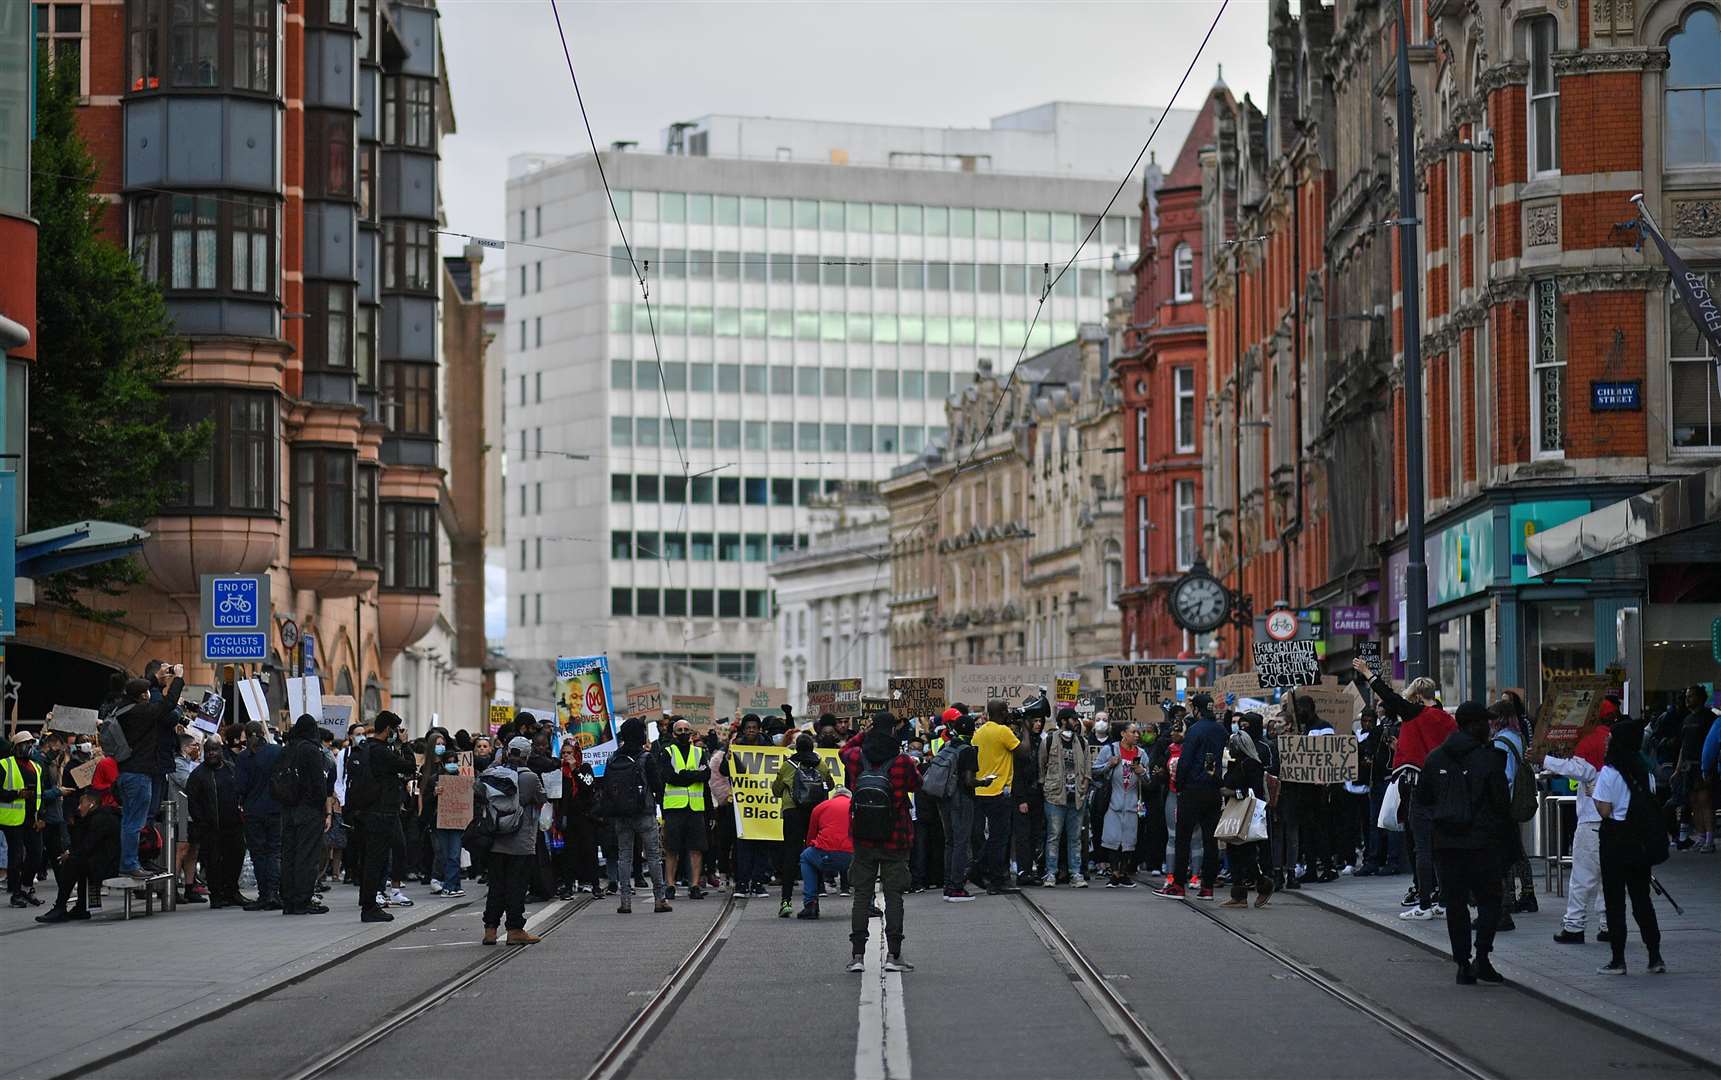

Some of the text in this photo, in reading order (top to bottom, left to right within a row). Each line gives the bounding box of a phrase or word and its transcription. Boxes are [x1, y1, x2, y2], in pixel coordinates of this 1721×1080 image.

[1685, 272, 1721, 336] FRASER
[1542, 280, 1556, 361] DENTAL
[1597, 388, 1634, 396] CHERRY
[1599, 396, 1633, 404] STREET
[1546, 371, 1559, 450] SURGERY
[218, 583, 254, 591] END OF
[220, 615, 251, 623] ROUTE
[1335, 621, 1370, 630] CAREERS
[213, 637, 258, 645] CYCLISTS
[1274, 640, 1314, 653] MENTALITY
[210, 646, 262, 654] DISMOUNT
[1287, 650, 1315, 663] CHANGE
[1103, 665, 1114, 680] IF
[1117, 664, 1134, 678] YOU
[1159, 664, 1176, 677] SEE
[1256, 662, 1291, 675] NEITHER
[1290, 661, 1308, 674] WILL
[890, 678, 944, 689] BLACK LIVES
[1057, 679, 1073, 687] BLACK
[1104, 679, 1119, 692] THE
[1120, 677, 1146, 692] RACISM
[1261, 671, 1316, 687] SOCIETY
[834, 690, 858, 703] WHITE
[903, 689, 929, 700] MATTER
[987, 686, 1021, 698] BLACK
[1143, 691, 1161, 706] THE
[628, 693, 661, 712] #BLM
[891, 698, 945, 709] TODAY TOMORROW
[907, 708, 936, 718] FOREVER
[1279, 736, 1357, 753] IF ALL LIVES
[733, 751, 780, 775] WE
[1340, 753, 1349, 770] Y
[1327, 766, 1357, 782] HERE
[731, 777, 772, 789] Wind
[743, 806, 782, 820] Blac
